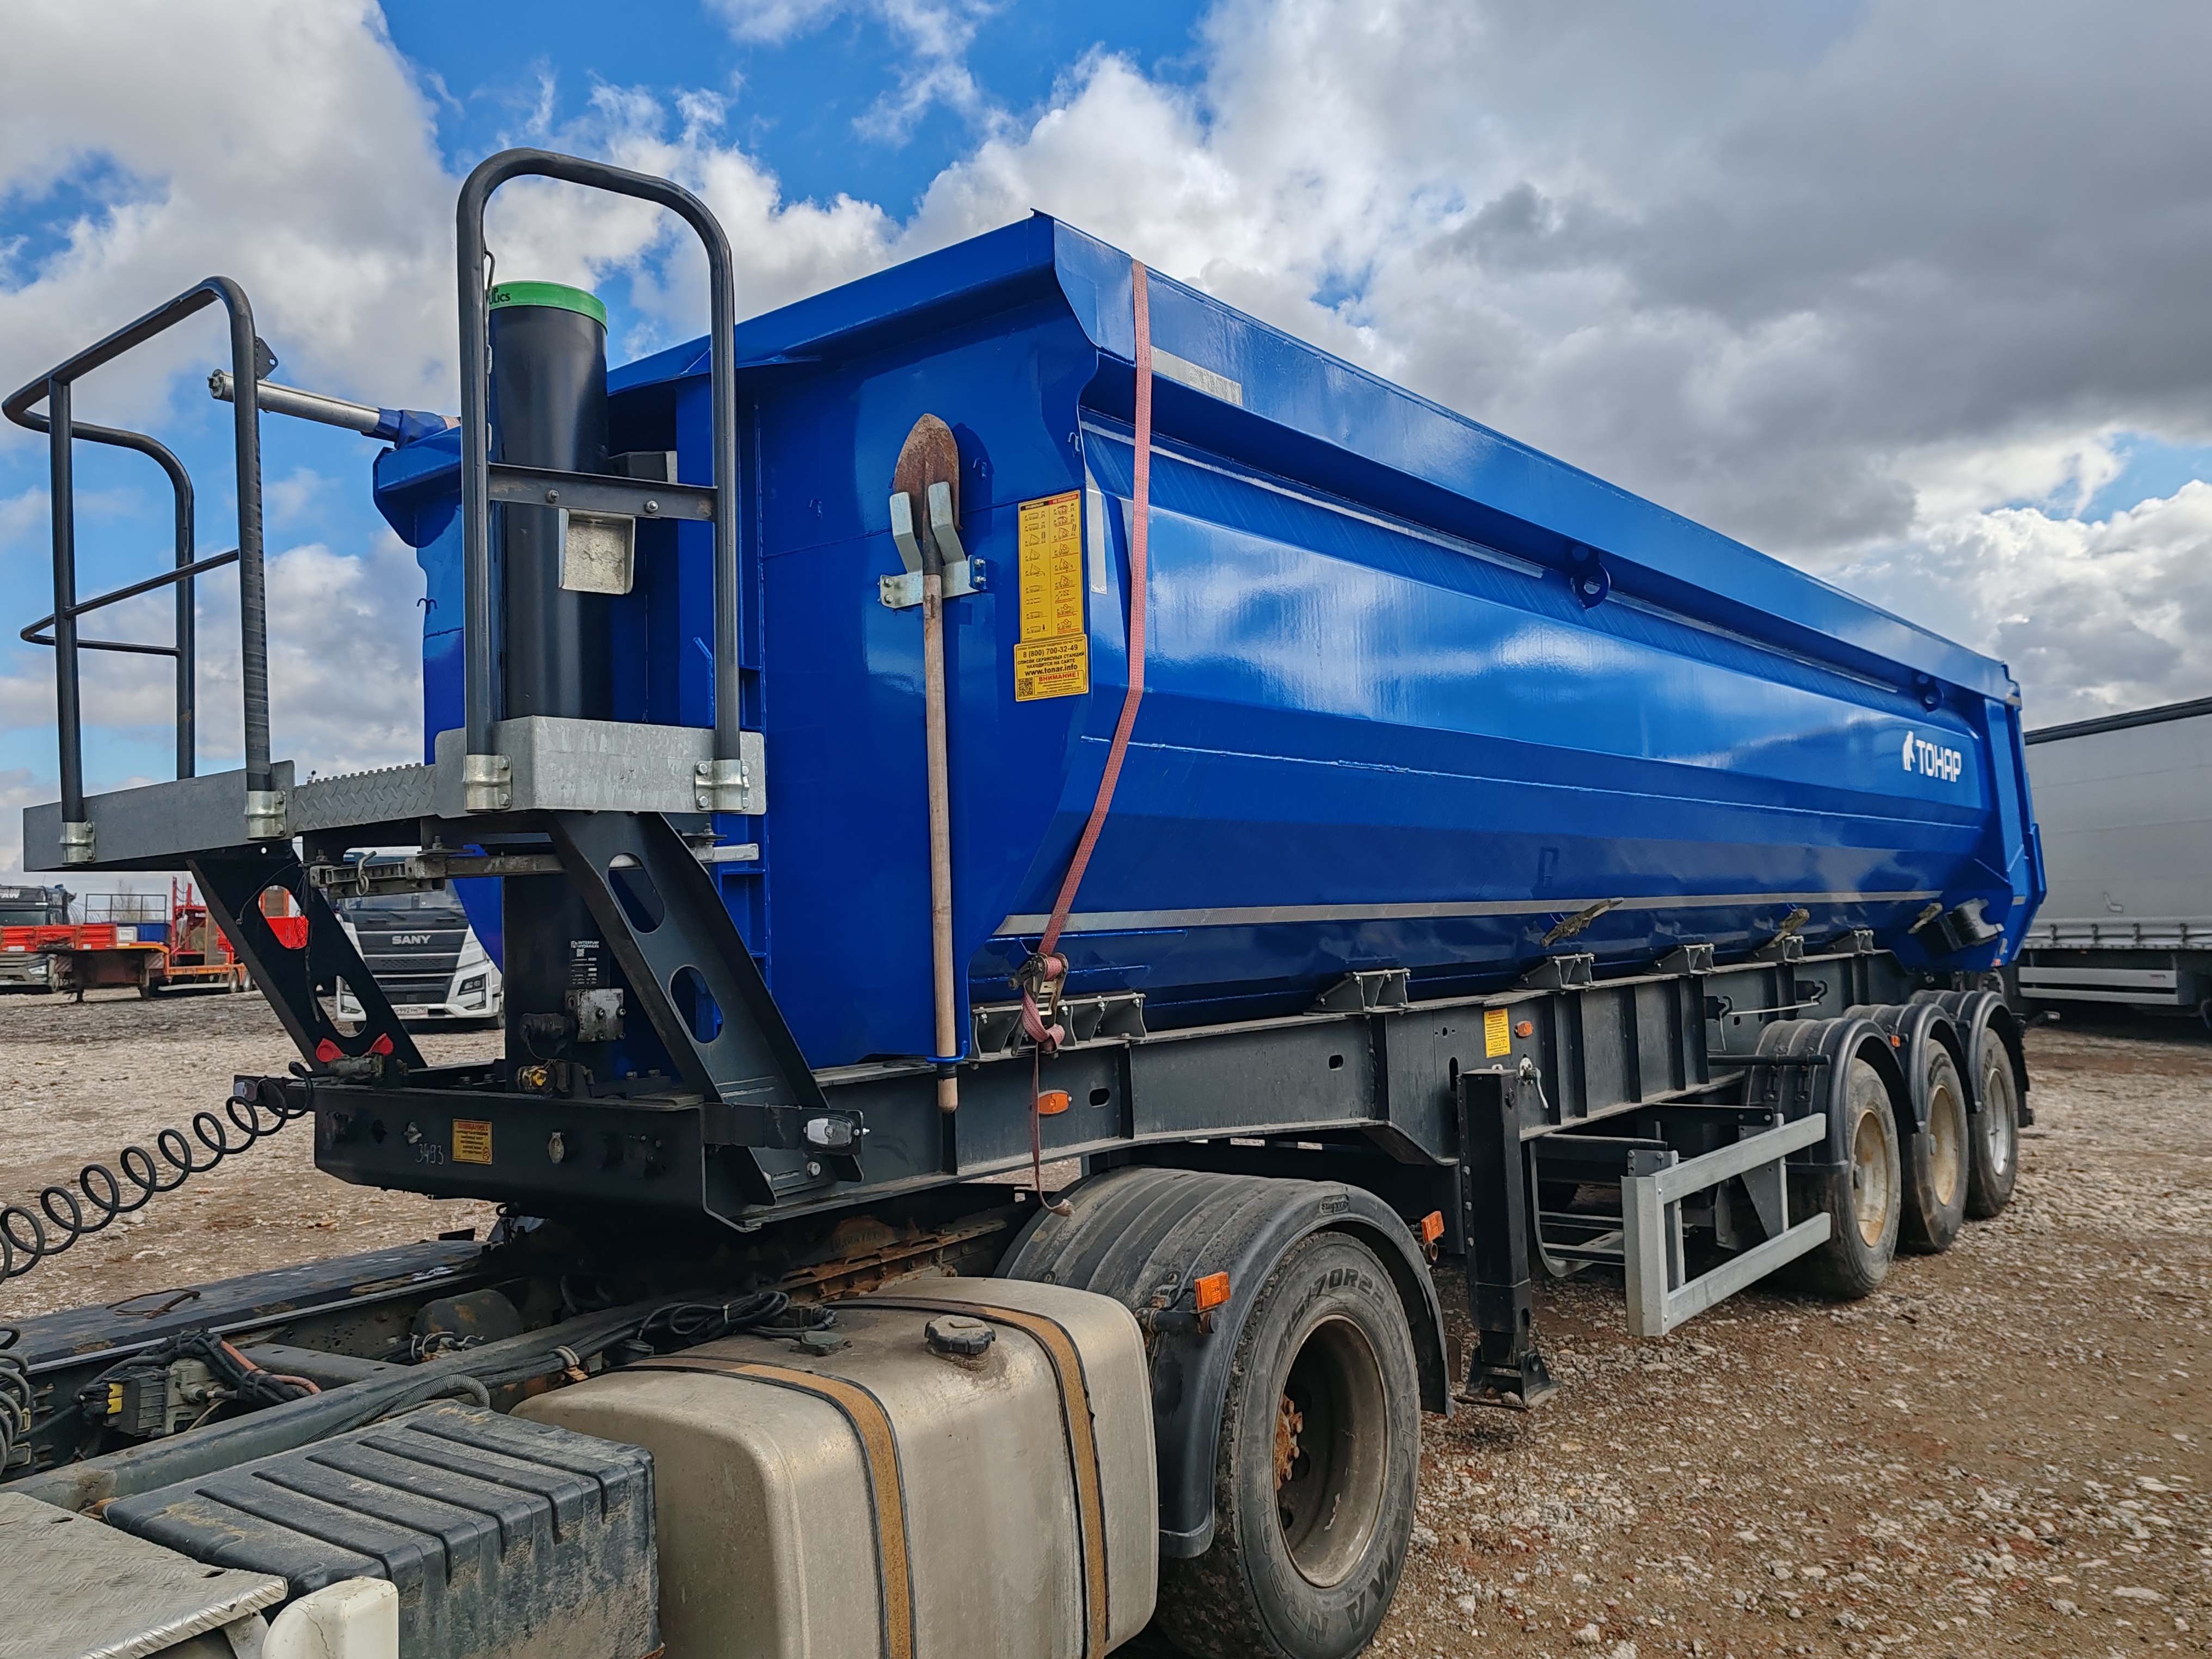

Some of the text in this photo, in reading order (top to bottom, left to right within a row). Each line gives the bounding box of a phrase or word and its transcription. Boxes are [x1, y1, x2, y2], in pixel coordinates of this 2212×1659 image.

[1029, 649, 1044, 658] (800)
[1046, 644, 1078, 654] 700-32-49
[1024, 663, 1078, 677] www.tonar.info
[1915, 739, 1961, 783] ТОНАР
[392, 935, 431, 944] SANY
